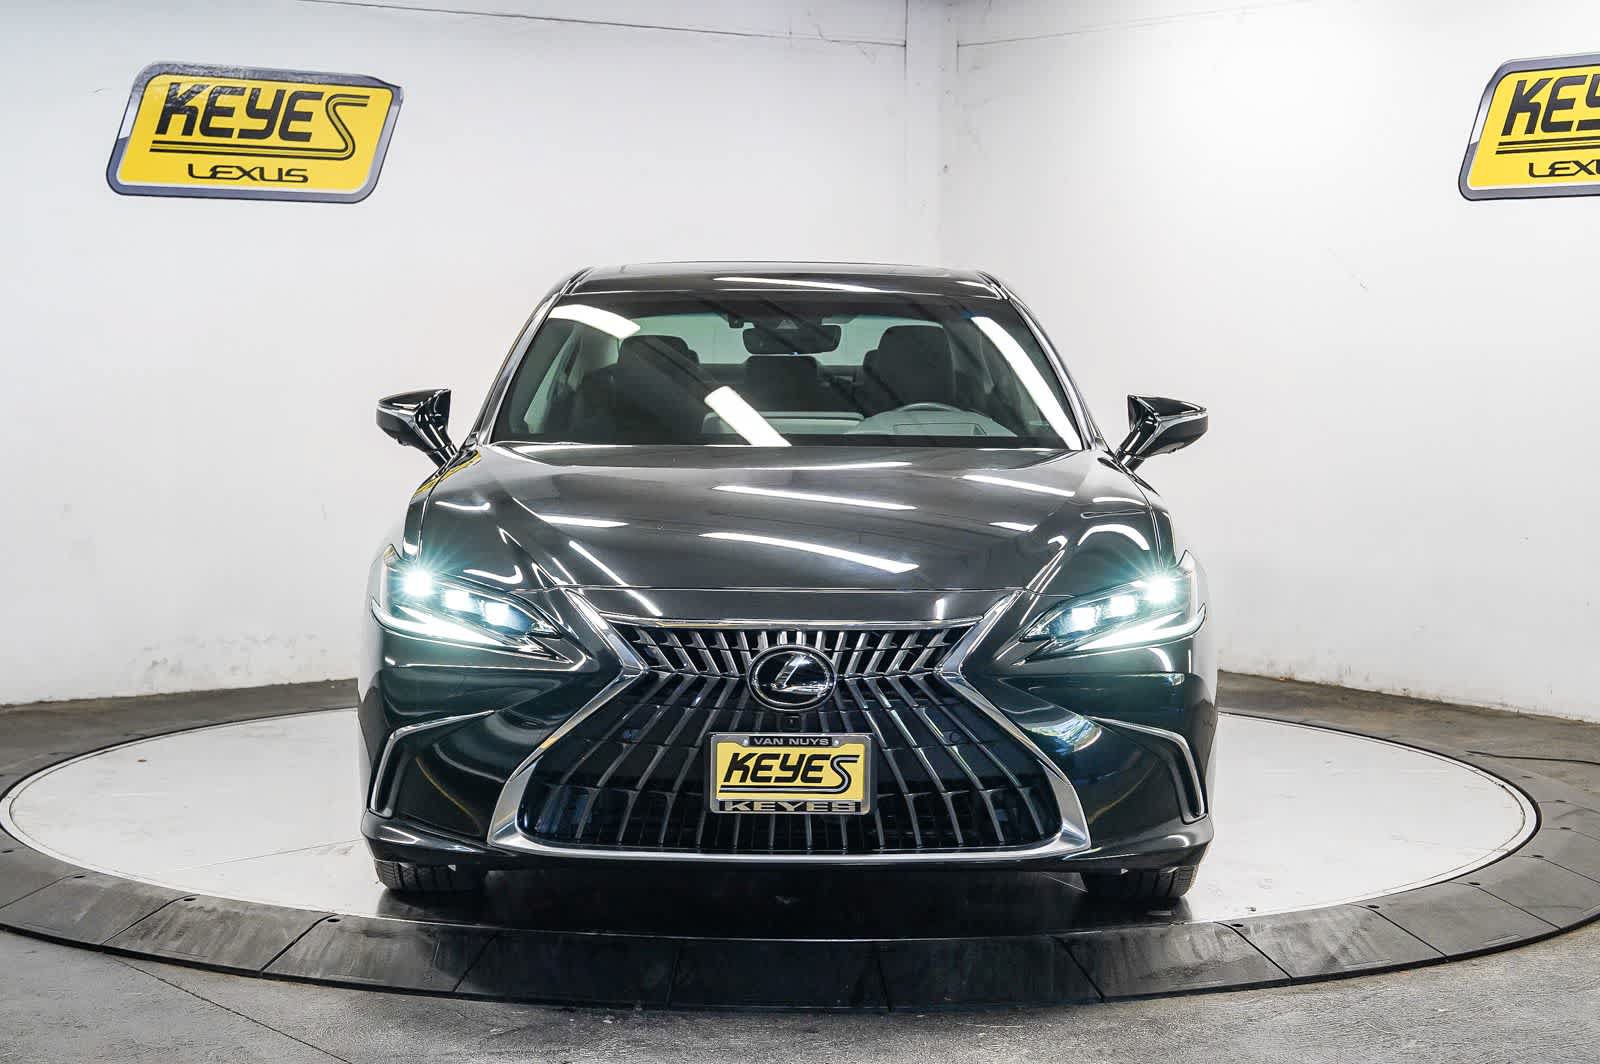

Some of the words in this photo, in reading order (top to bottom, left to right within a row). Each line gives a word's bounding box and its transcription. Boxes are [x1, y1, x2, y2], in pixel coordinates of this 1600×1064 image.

[150, 82, 370, 160] KEYES
[188, 163, 309, 183] LEXUS
[1528, 159, 1600, 178] LEX
[754, 738, 784, 746] VAN
[789, 738, 829, 746] NUYS
[719, 752, 860, 795] KEYES
[724, 801, 856, 812] KEYES
